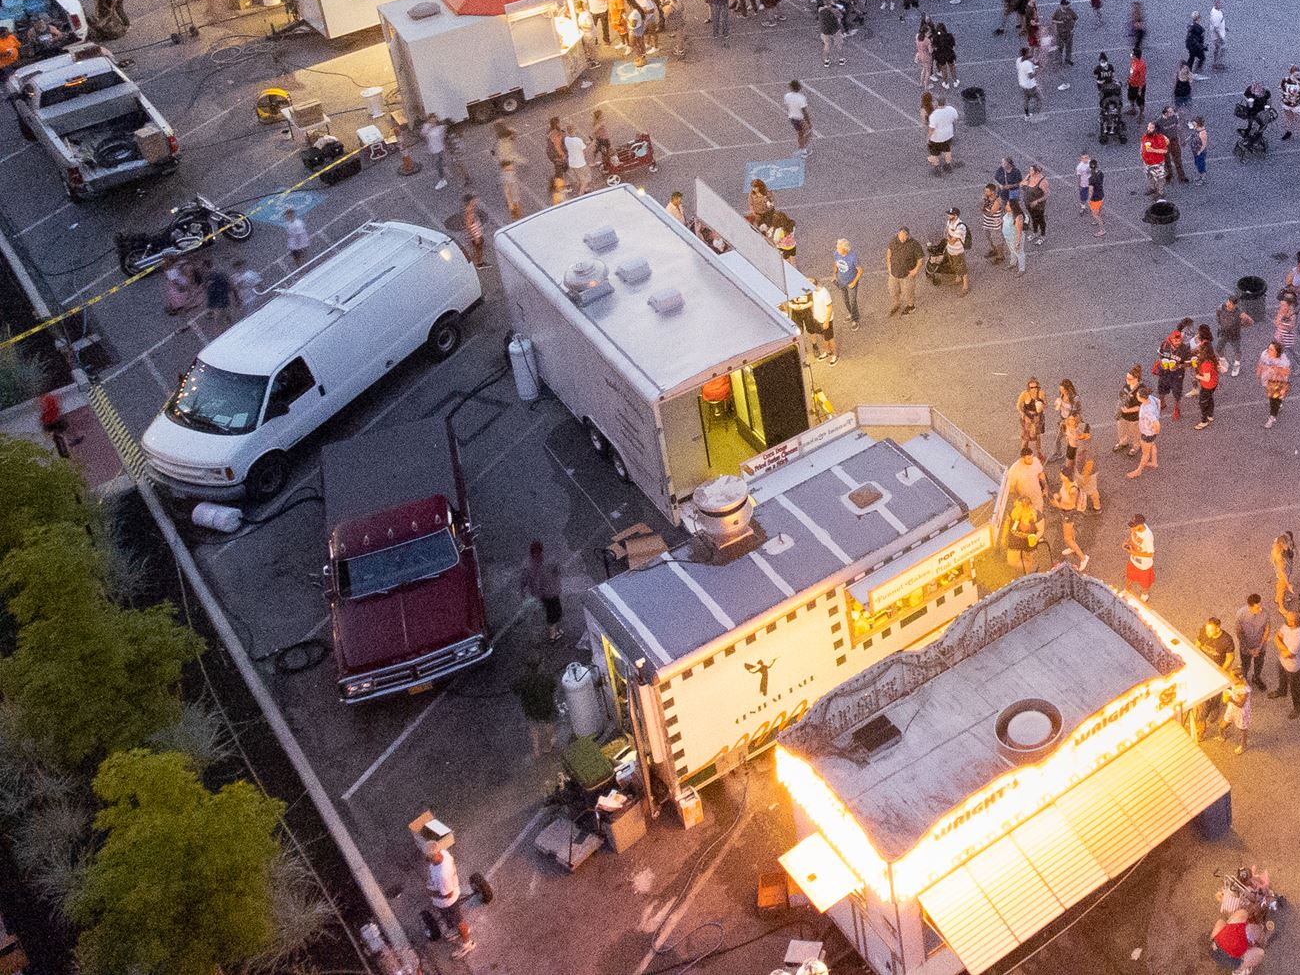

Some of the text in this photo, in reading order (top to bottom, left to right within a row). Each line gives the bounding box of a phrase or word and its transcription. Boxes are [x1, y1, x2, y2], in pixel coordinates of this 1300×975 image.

[938, 550, 955, 565] POP
[1073, 687, 1152, 747] WRIGHT'S
[933, 778, 1019, 842] WRIGHT'S
